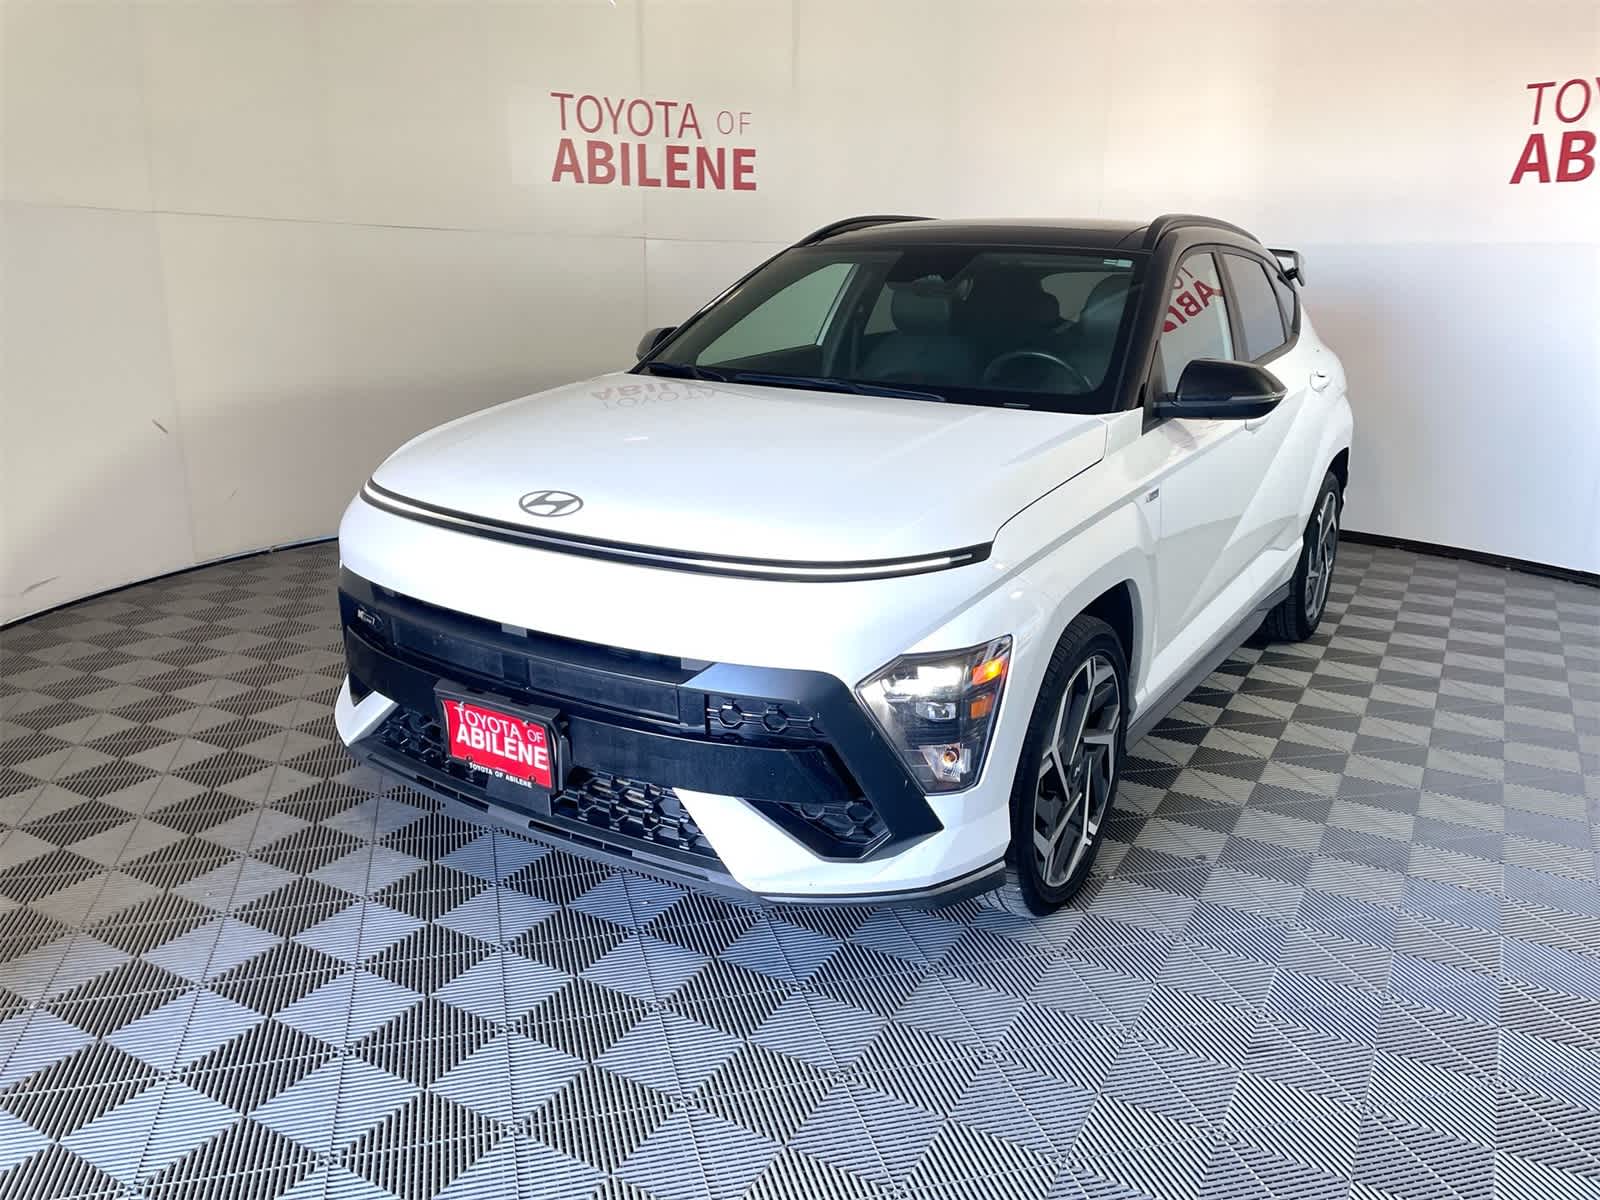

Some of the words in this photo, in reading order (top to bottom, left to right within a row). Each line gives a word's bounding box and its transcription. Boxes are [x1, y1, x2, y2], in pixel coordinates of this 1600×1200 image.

[550, 92, 702, 139] TOYOTA
[717, 110, 752, 135] OF
[1526, 76, 1600, 125] TO
[551, 138, 757, 191] ABILENE
[454, 706, 521, 740] TOYOTA
[527, 729, 544, 743] OF
[456, 723, 549, 771] ABILENE
[469, 762, 493, 776] TOYOTA
[505, 774, 532, 789] ABILENE
